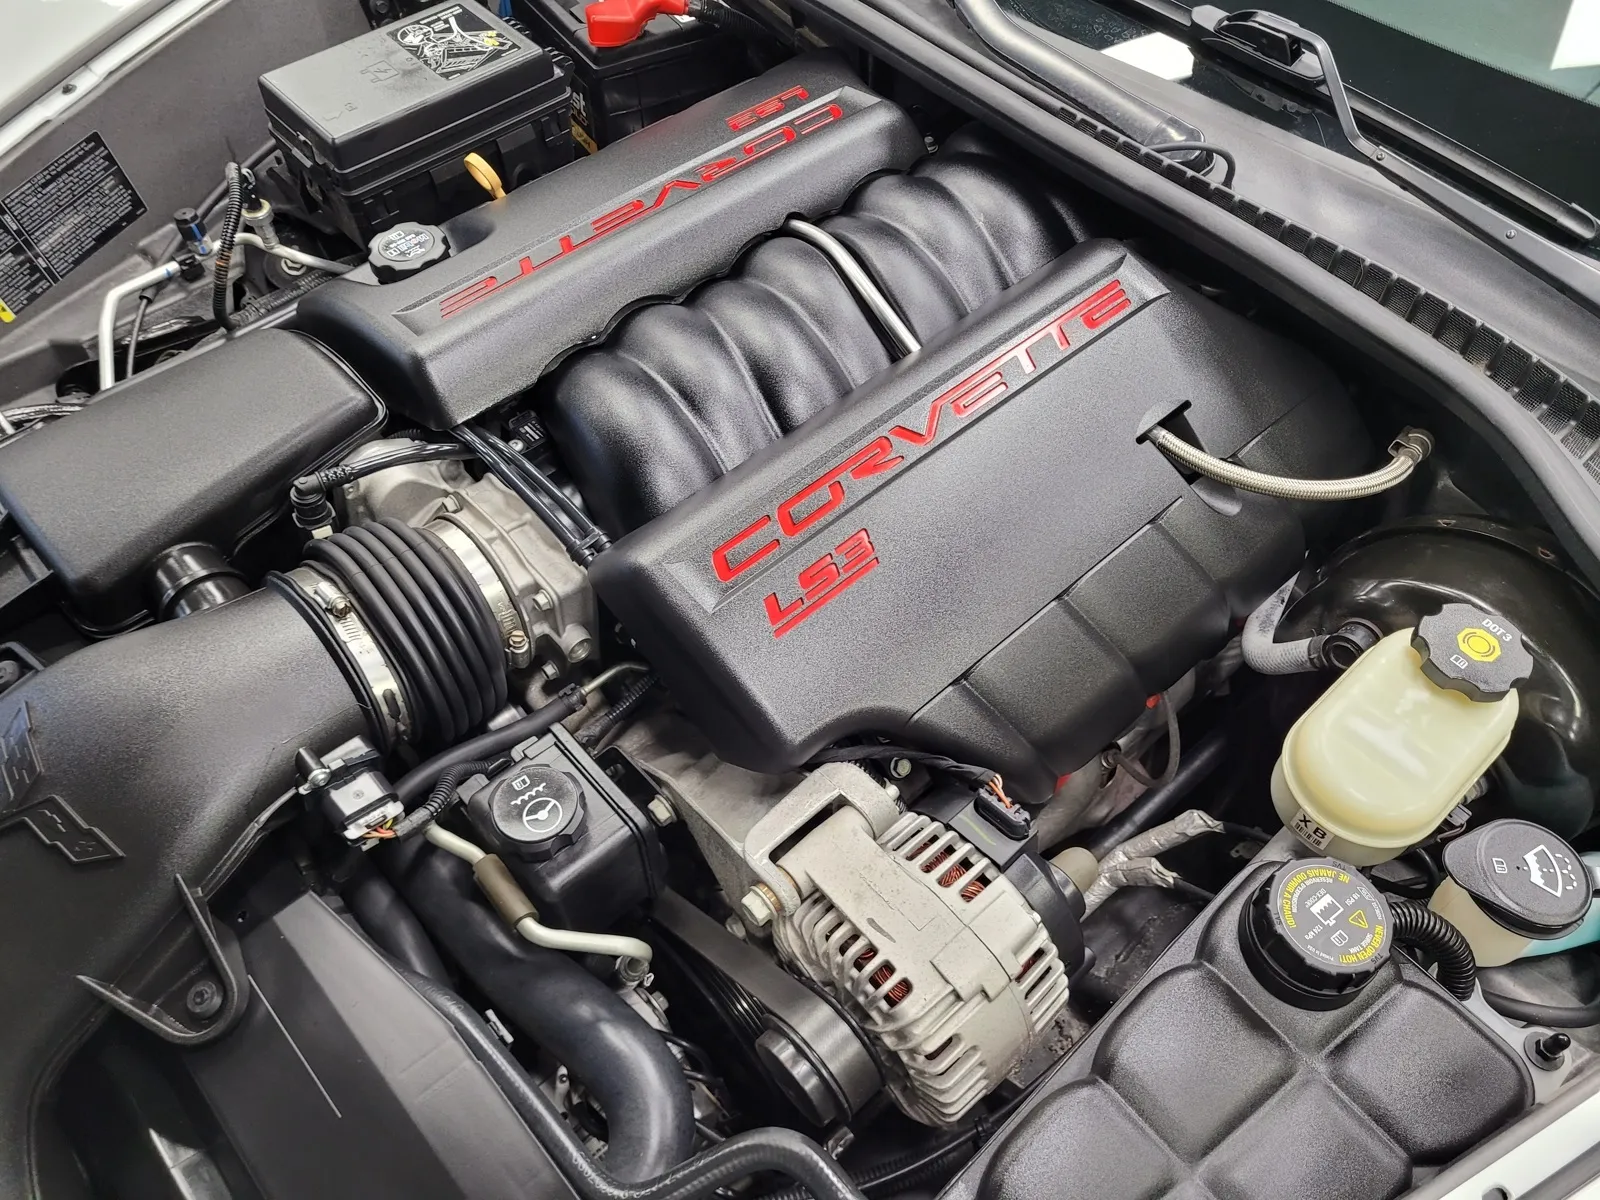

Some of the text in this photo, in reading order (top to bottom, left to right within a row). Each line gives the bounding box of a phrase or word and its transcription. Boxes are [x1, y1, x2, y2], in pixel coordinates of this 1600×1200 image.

[727, 85, 809, 131] LS3
[440, 103, 843, 318] CORVETTE
[712, 279, 1131, 583] CORVETTE
[763, 527, 875, 627] LS3
[1481, 618, 1513, 642] DOT 3
[1285, 872, 1308, 893] OUVRIR
[1306, 868, 1337, 878] JAMAIS
[1338, 872, 1350, 884] NE
[1344, 896, 1356, 907] PSI
[1282, 899, 1297, 929] CHAUD!
[1304, 924, 1323, 940] 124 kPa
[1338, 924, 1384, 963] NEVER OPEN HOT!
[1370, 952, 1384, 965] TVS
